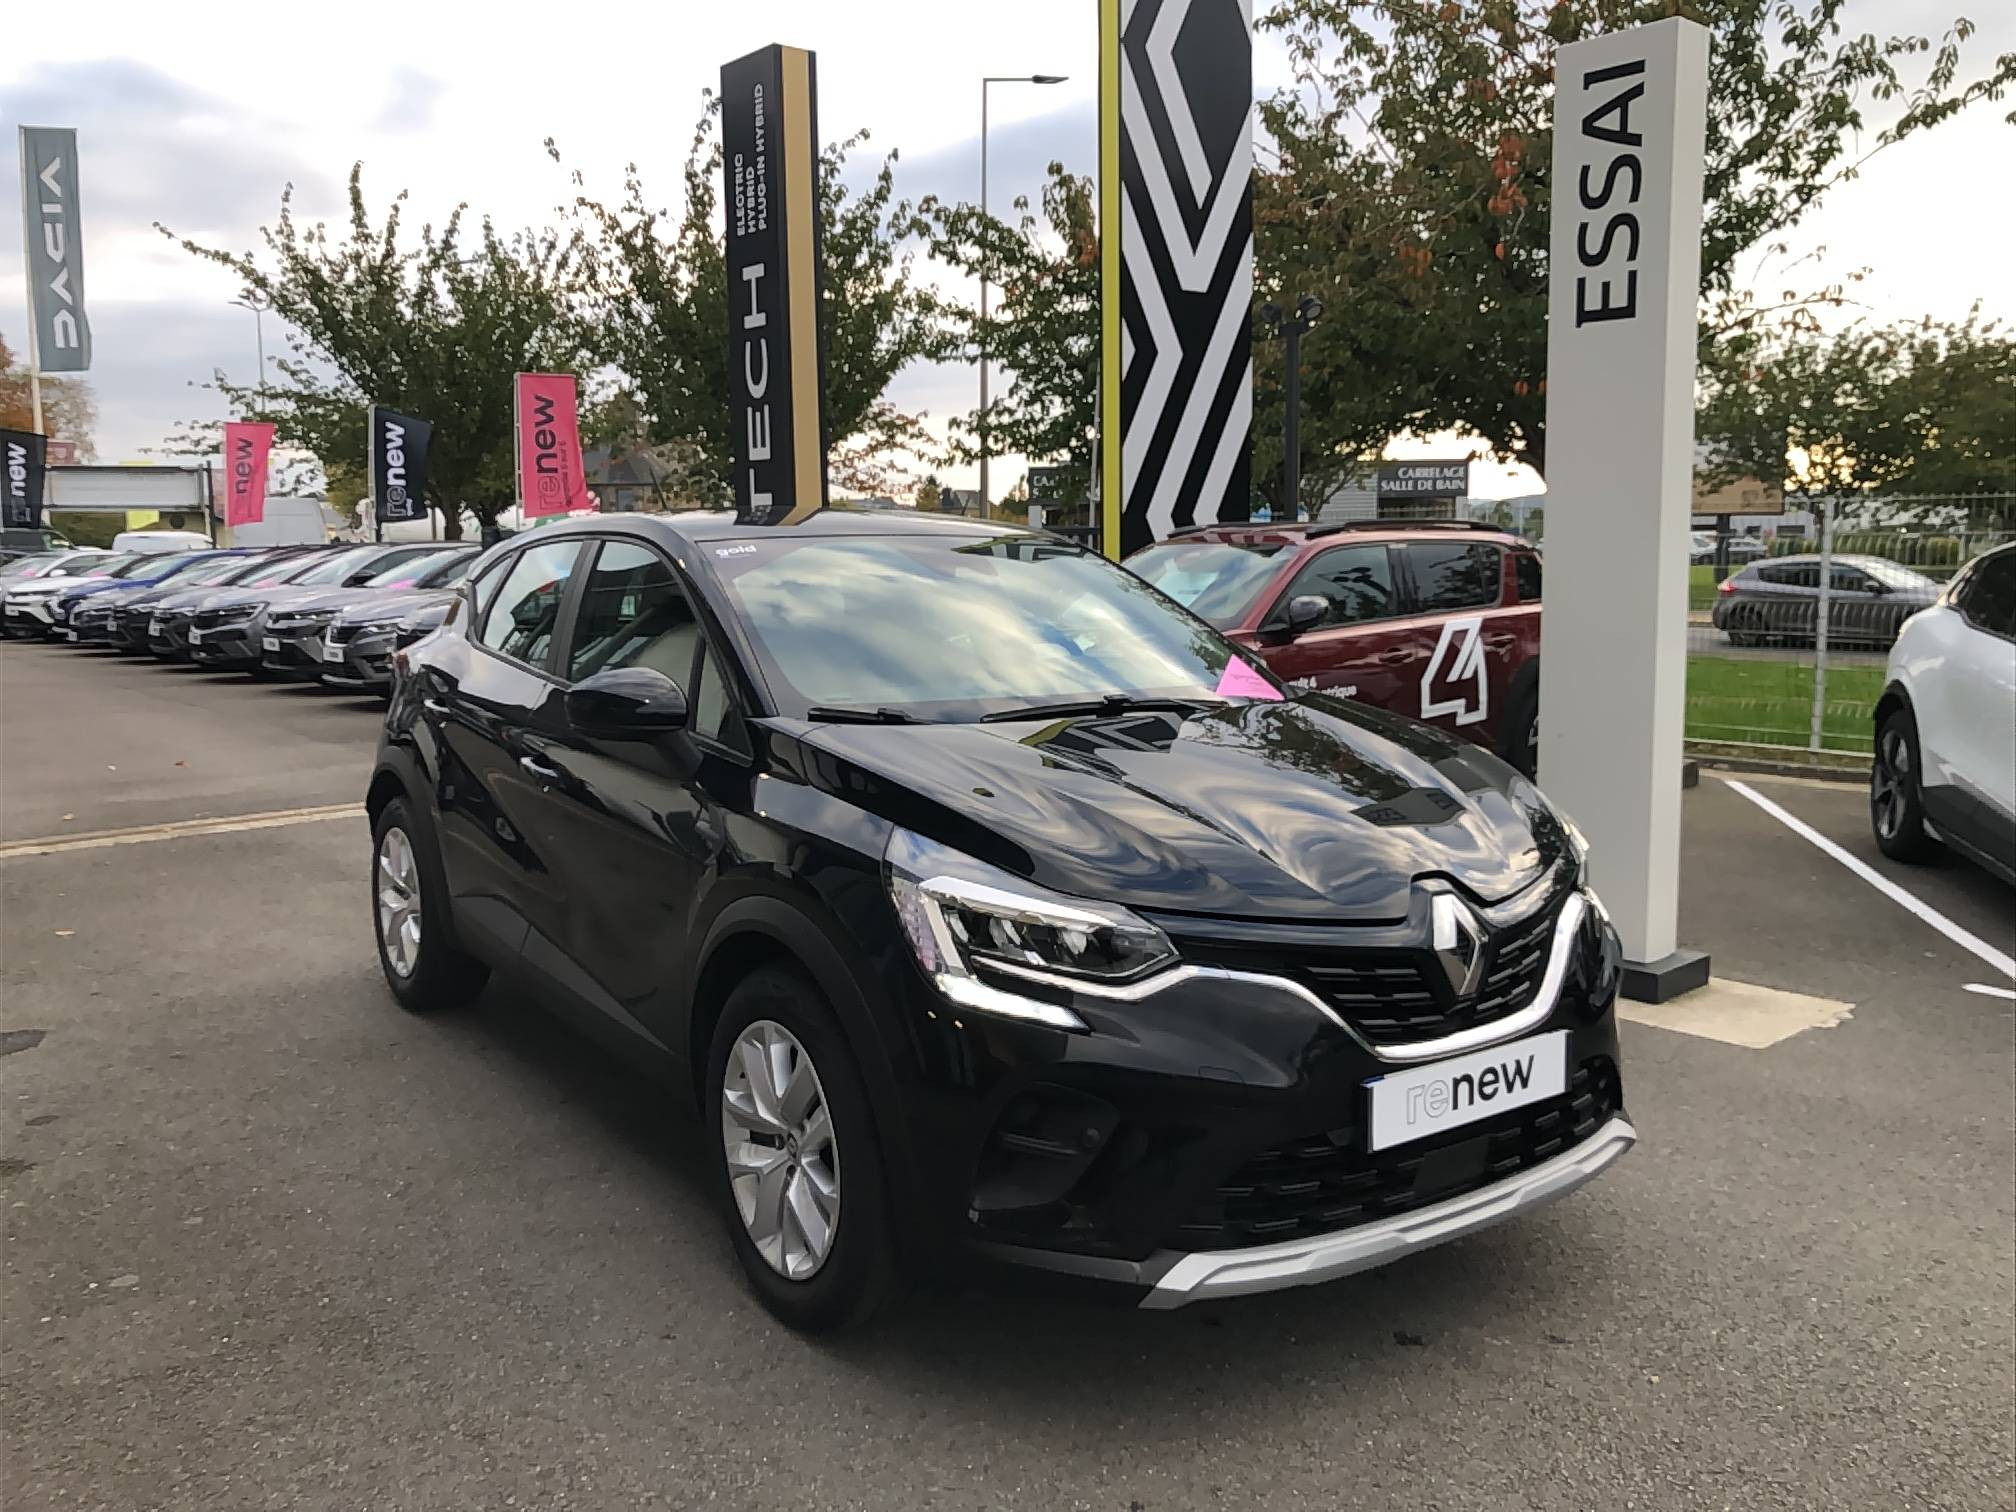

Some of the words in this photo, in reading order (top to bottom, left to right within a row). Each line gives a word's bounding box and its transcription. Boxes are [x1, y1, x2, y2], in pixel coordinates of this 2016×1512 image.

[754, 83, 765, 152] HYBRID
[734, 153, 746, 237] ELECTRIC
[745, 166, 757, 234] HYBRID
[756, 155, 767, 231] PLUG-IN
[1575, 59, 1646, 328] ESSAI
[39, 156, 80, 349] DACIA
[7, 441, 28, 521] rnew
[385, 421, 406, 516] renew
[533, 393, 563, 510] renew
[1381, 479, 1414, 491] SALLE
[1417, 479, 1433, 491] DE
[1435, 479, 1465, 490] BAIN
[1398, 467, 1465, 479] CARRELAGE
[1407, 1055, 1535, 1125] renew
